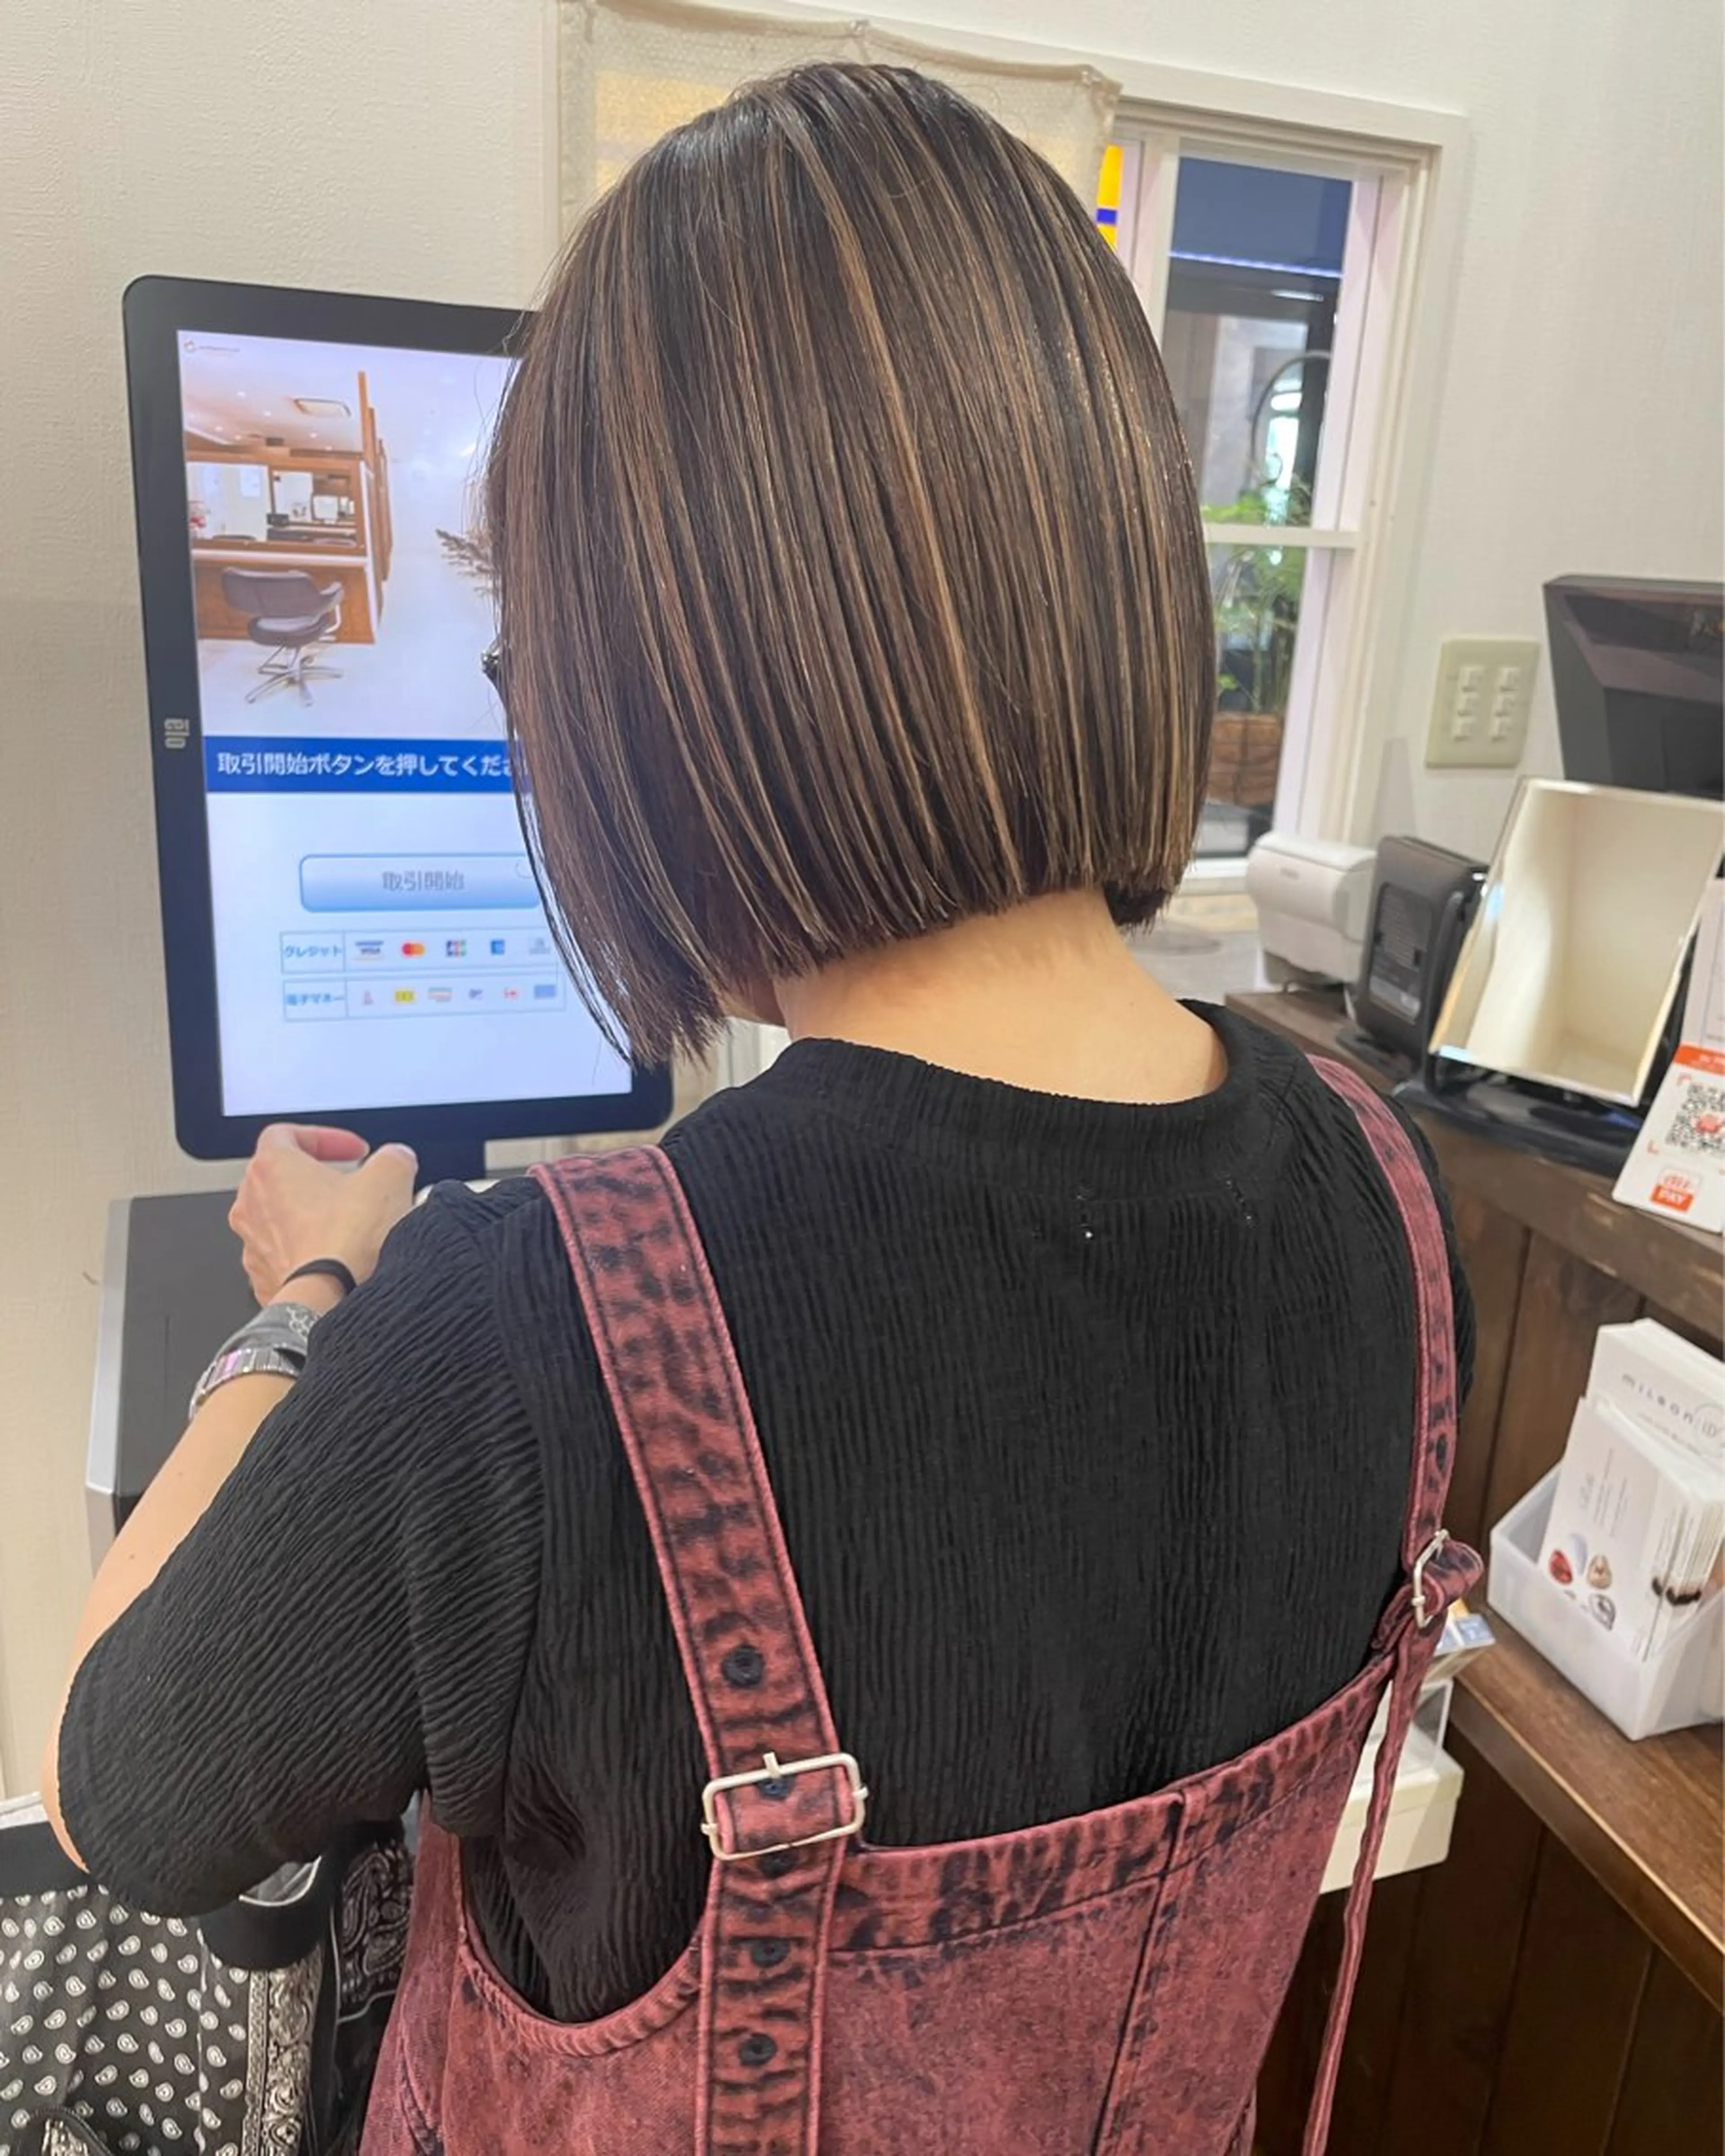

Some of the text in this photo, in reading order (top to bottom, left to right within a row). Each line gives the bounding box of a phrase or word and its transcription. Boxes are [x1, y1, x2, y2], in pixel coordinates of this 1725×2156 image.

[164, 717, 190, 749] elo
[217, 751, 528, 777] 取引開始ボタンを押してくださ
[382, 869, 464, 892] 取引開始
[284, 945, 343, 958] クレジット
